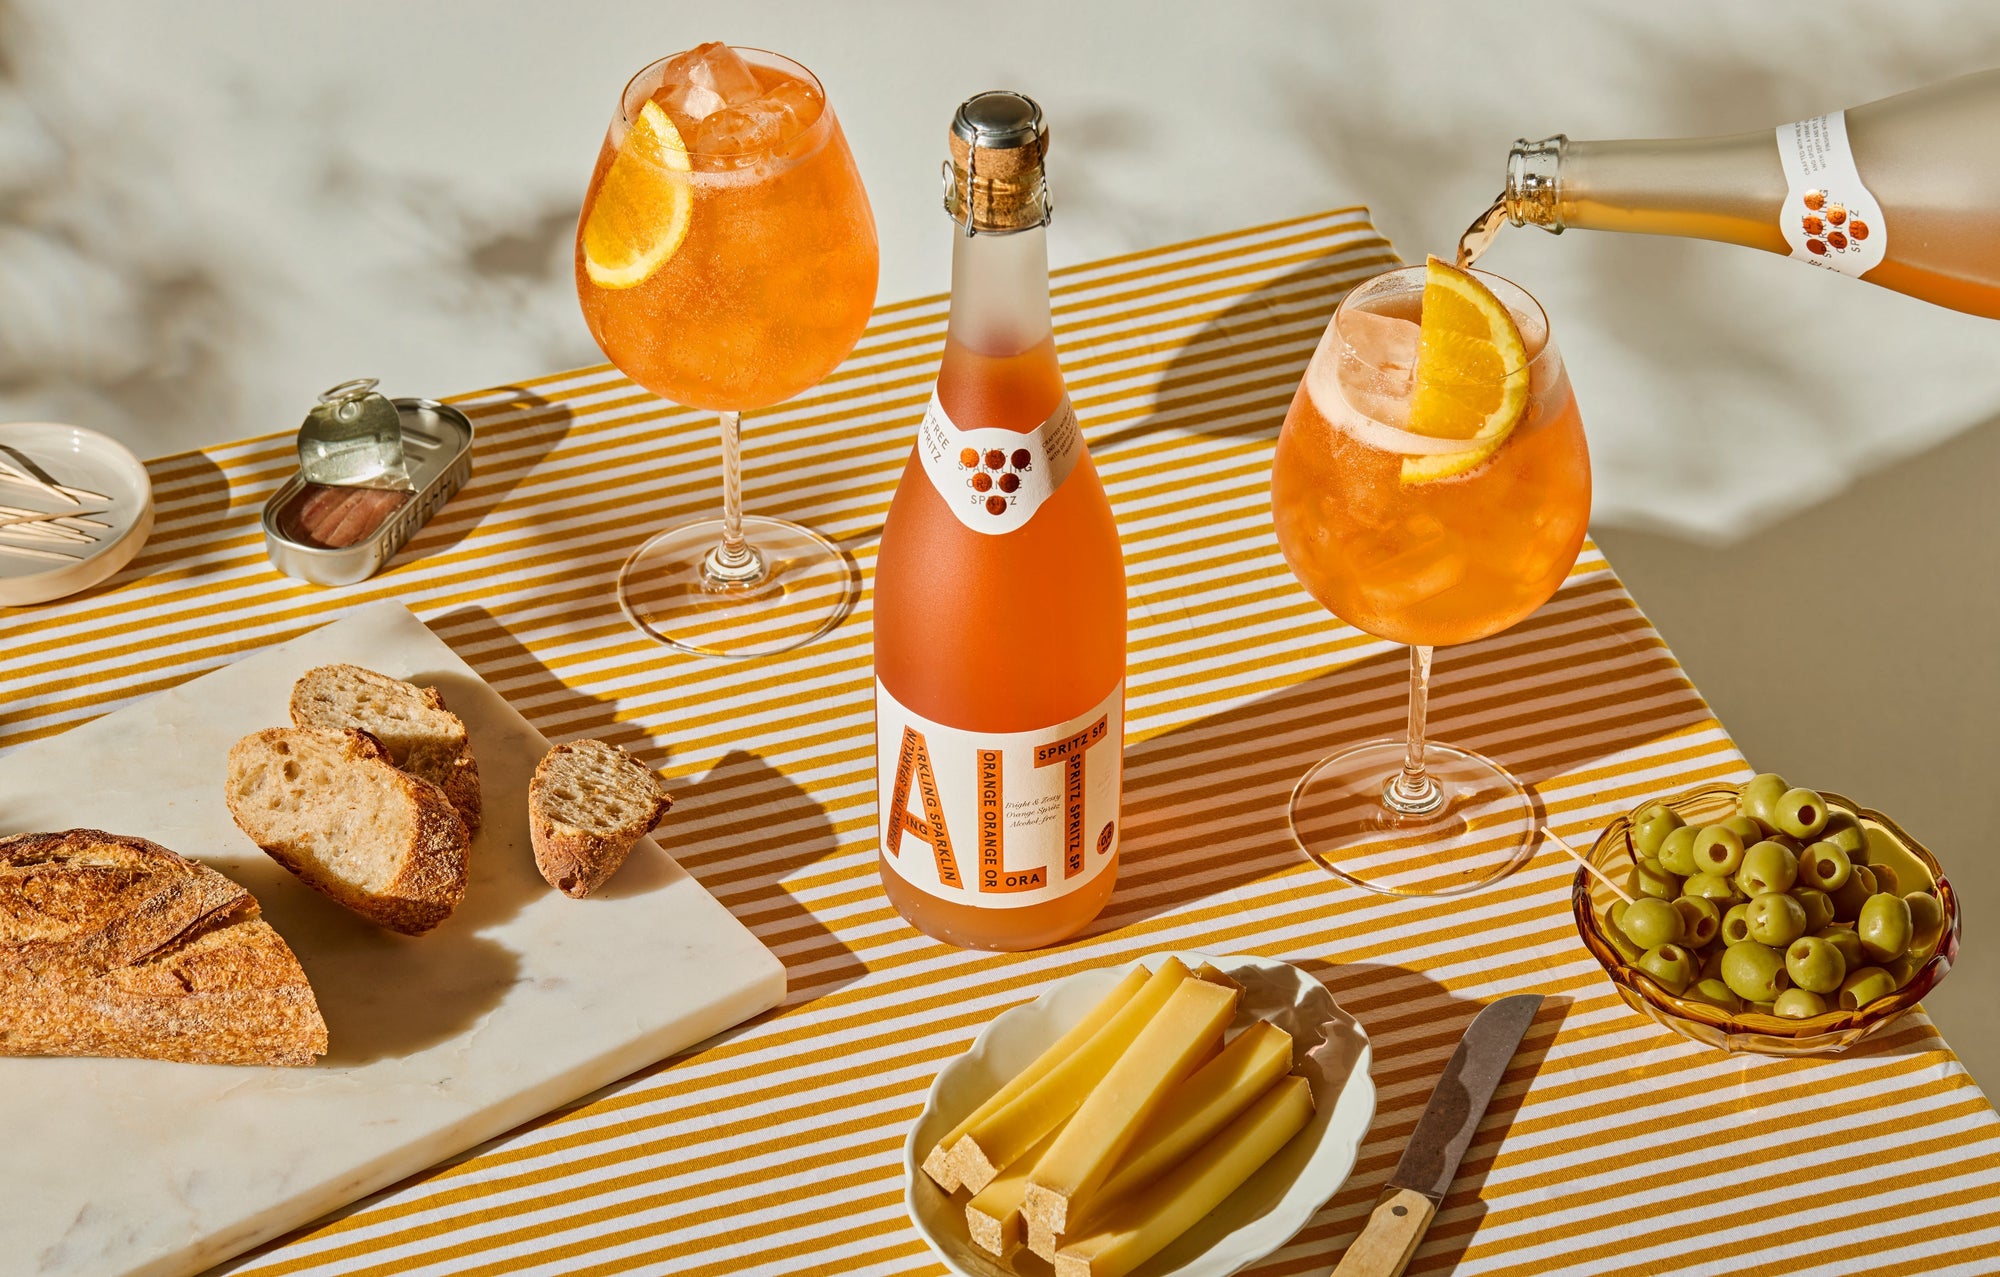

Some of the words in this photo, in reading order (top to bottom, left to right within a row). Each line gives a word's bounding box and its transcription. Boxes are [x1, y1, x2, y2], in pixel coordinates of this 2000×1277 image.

[901, 729, 918, 787] SPARKLIN
[1038, 733, 1088, 760] SPRITZ
[1092, 721, 1105, 738] SP
[983, 752, 997, 807] ORANGE
[1069, 753, 1081, 802] SPRITZ
[905, 814, 929, 836] ING
[1037, 803, 1061, 814] Spritz
[1069, 804, 1081, 852] SPRITZ
[930, 813, 957, 881] SPARKLIN
[984, 811, 998, 866] ORANGE
[984, 870, 998, 888] OR
[1005, 873, 1040, 887] ORA
[1069, 854, 1080, 870] SP
